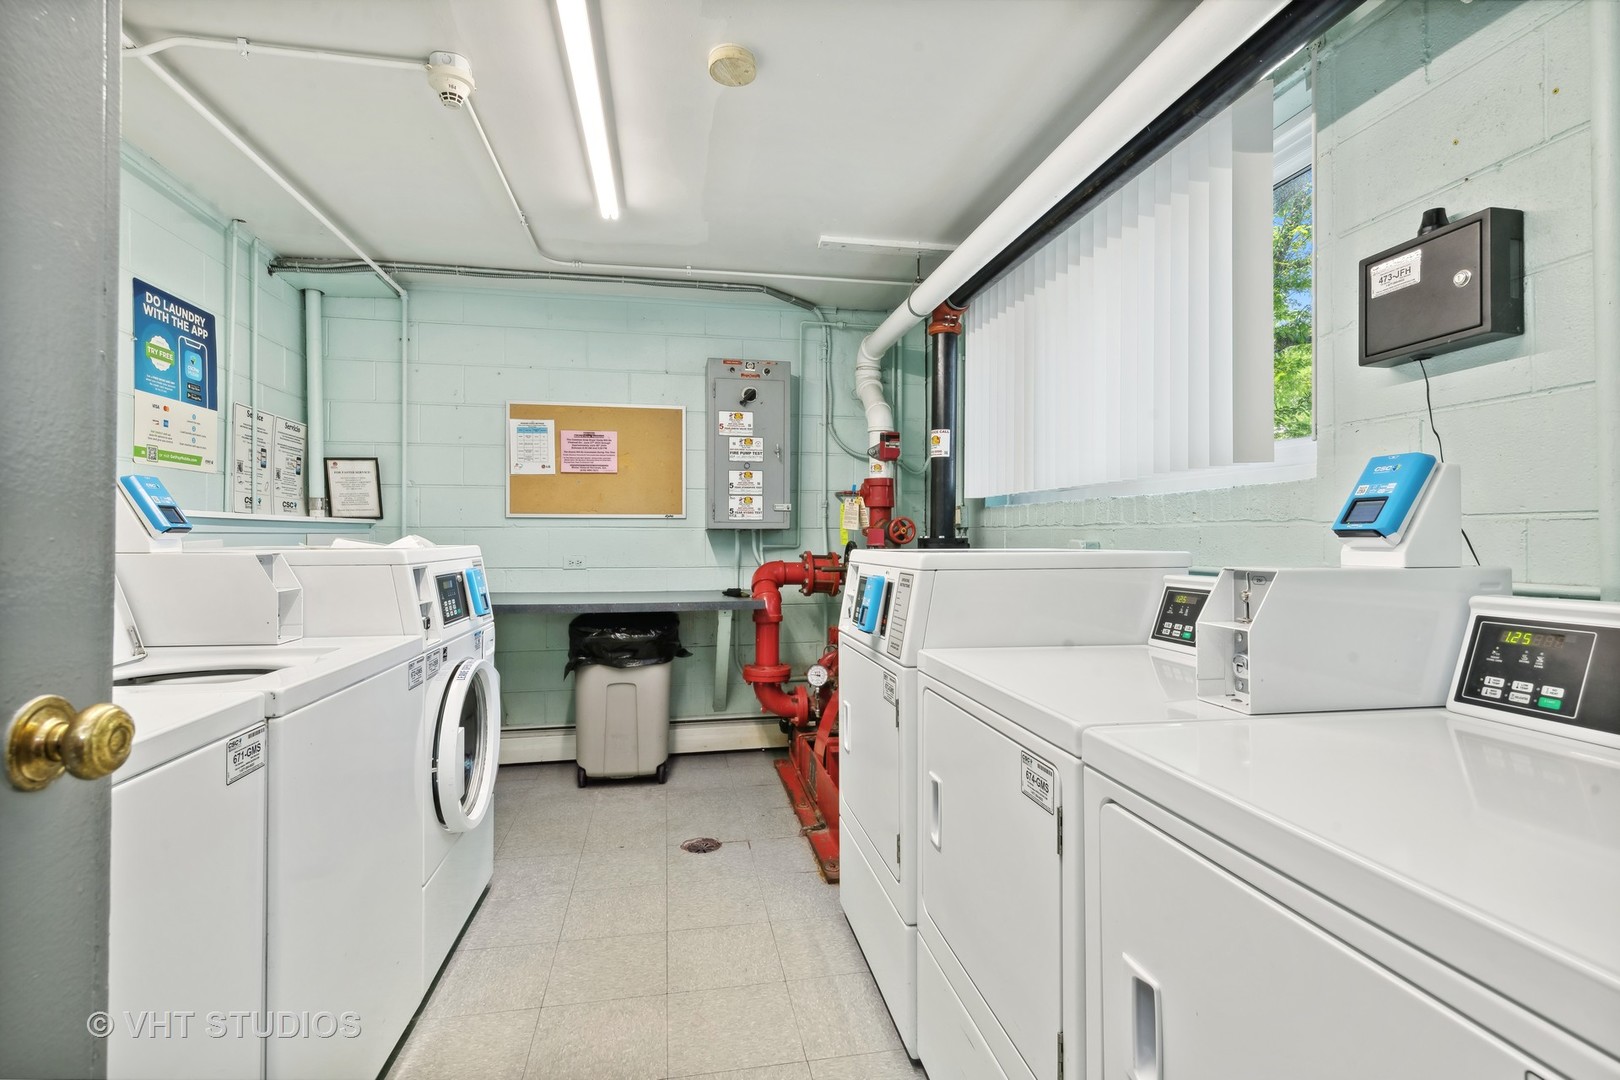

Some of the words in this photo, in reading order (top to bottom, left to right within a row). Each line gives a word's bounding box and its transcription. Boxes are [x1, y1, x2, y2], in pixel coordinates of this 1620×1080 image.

[1378, 266, 1412, 284] 473-JFH
[146, 292, 160, 307] DO
[164, 300, 206, 327] LAUNDRY
[143, 302, 170, 324] WITH
[171, 316, 189, 332] THE
[192, 325, 208, 339] APP
[148, 346, 158, 355] TRY
[159, 351, 173, 360] FREE
[246, 410, 264, 422] Seice
[284, 422, 300, 433] Servicio
[233, 743, 261, 764] 671-GMS
[1026, 770, 1049, 793] 674-GMS
